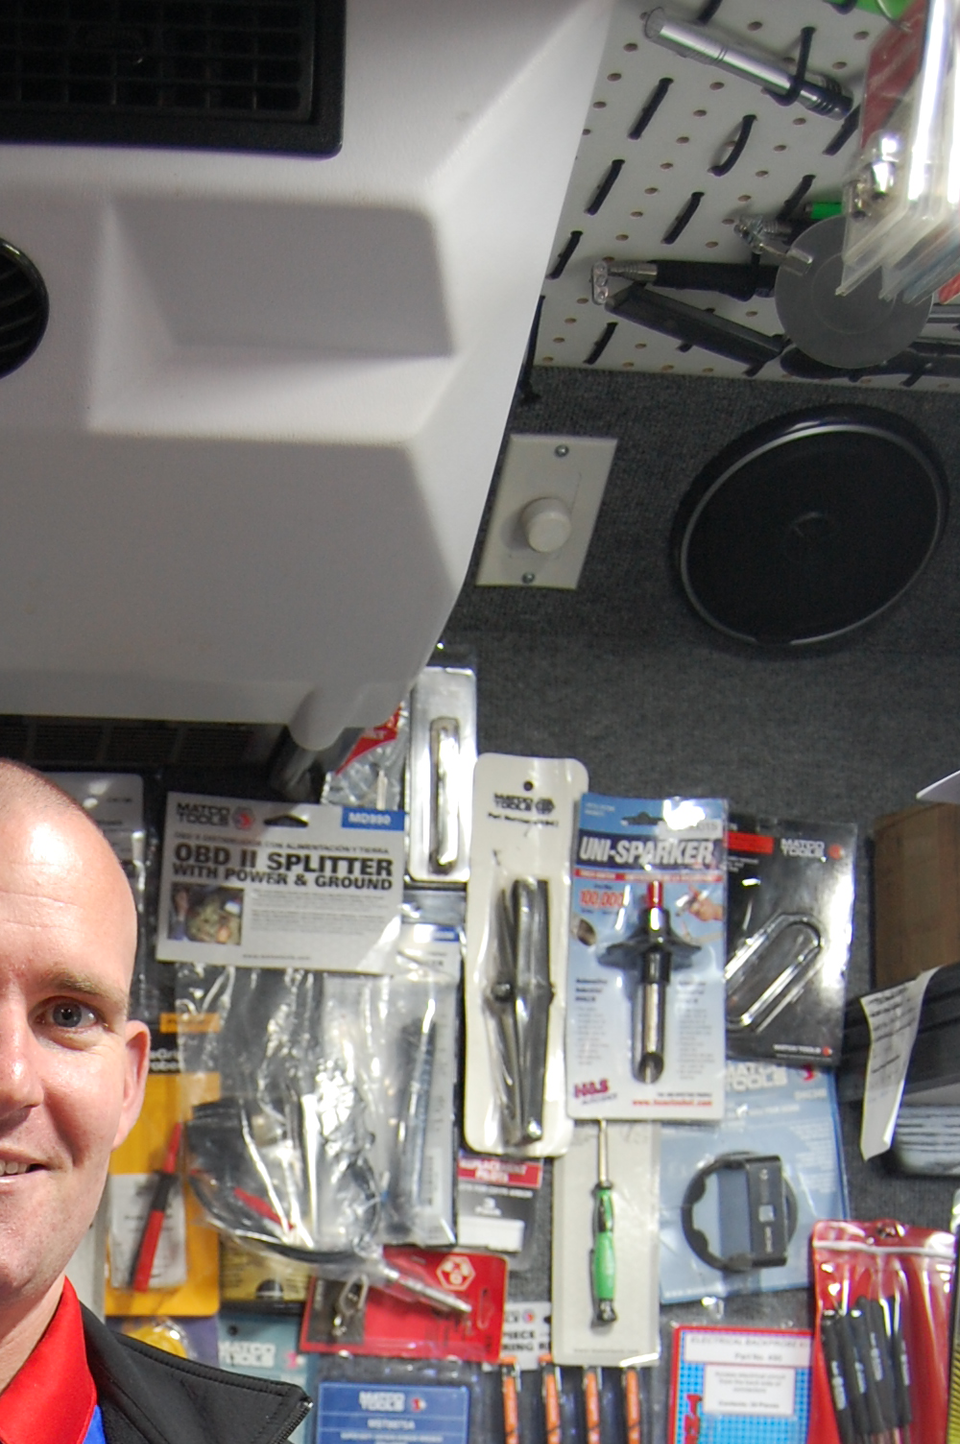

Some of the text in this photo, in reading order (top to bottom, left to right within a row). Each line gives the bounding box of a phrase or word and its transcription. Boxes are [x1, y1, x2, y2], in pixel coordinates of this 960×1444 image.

[579, 836, 715, 865] UNI-SPARKER
[781, 838, 825, 850] MATCO
[782, 847, 825, 859] TOOLS
[174, 842, 394, 877] OBD II SPLITTER
[173, 862, 393, 891] WITH POWER & GROUND
